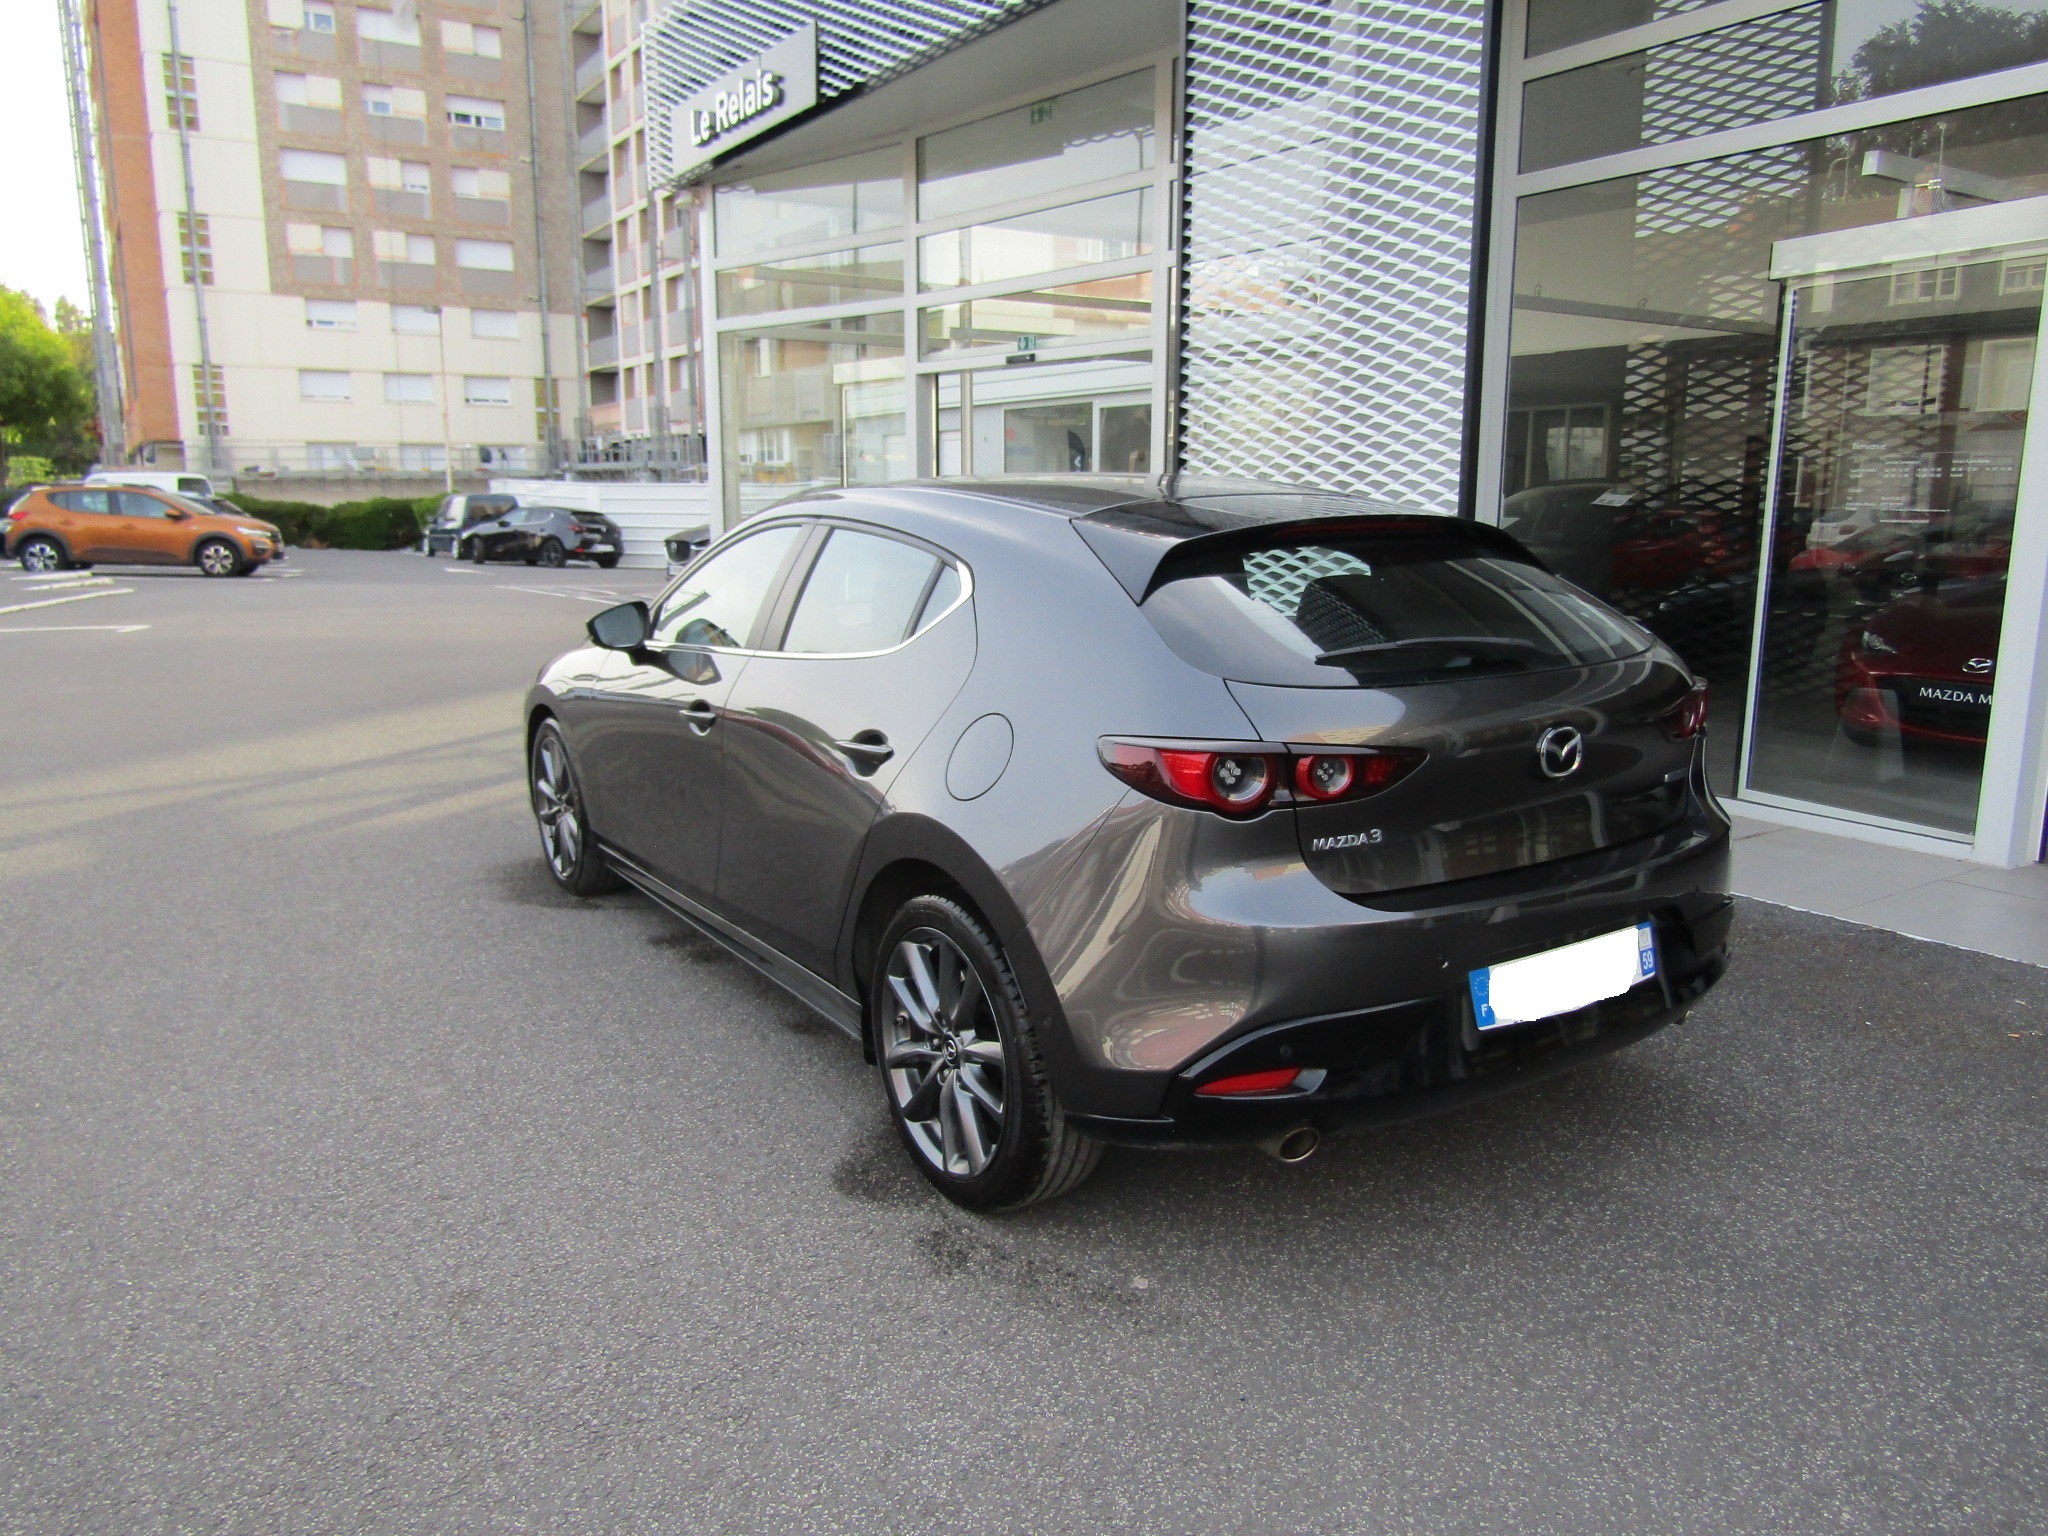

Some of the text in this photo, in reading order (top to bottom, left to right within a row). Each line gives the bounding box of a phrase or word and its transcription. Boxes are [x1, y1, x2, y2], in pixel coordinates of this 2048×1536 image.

[690, 68, 776, 147] Le Relais
[1919, 687, 1974, 703] MAZDA
[1642, 950, 1653, 969] 59
[1480, 1003, 1488, 1017] F
